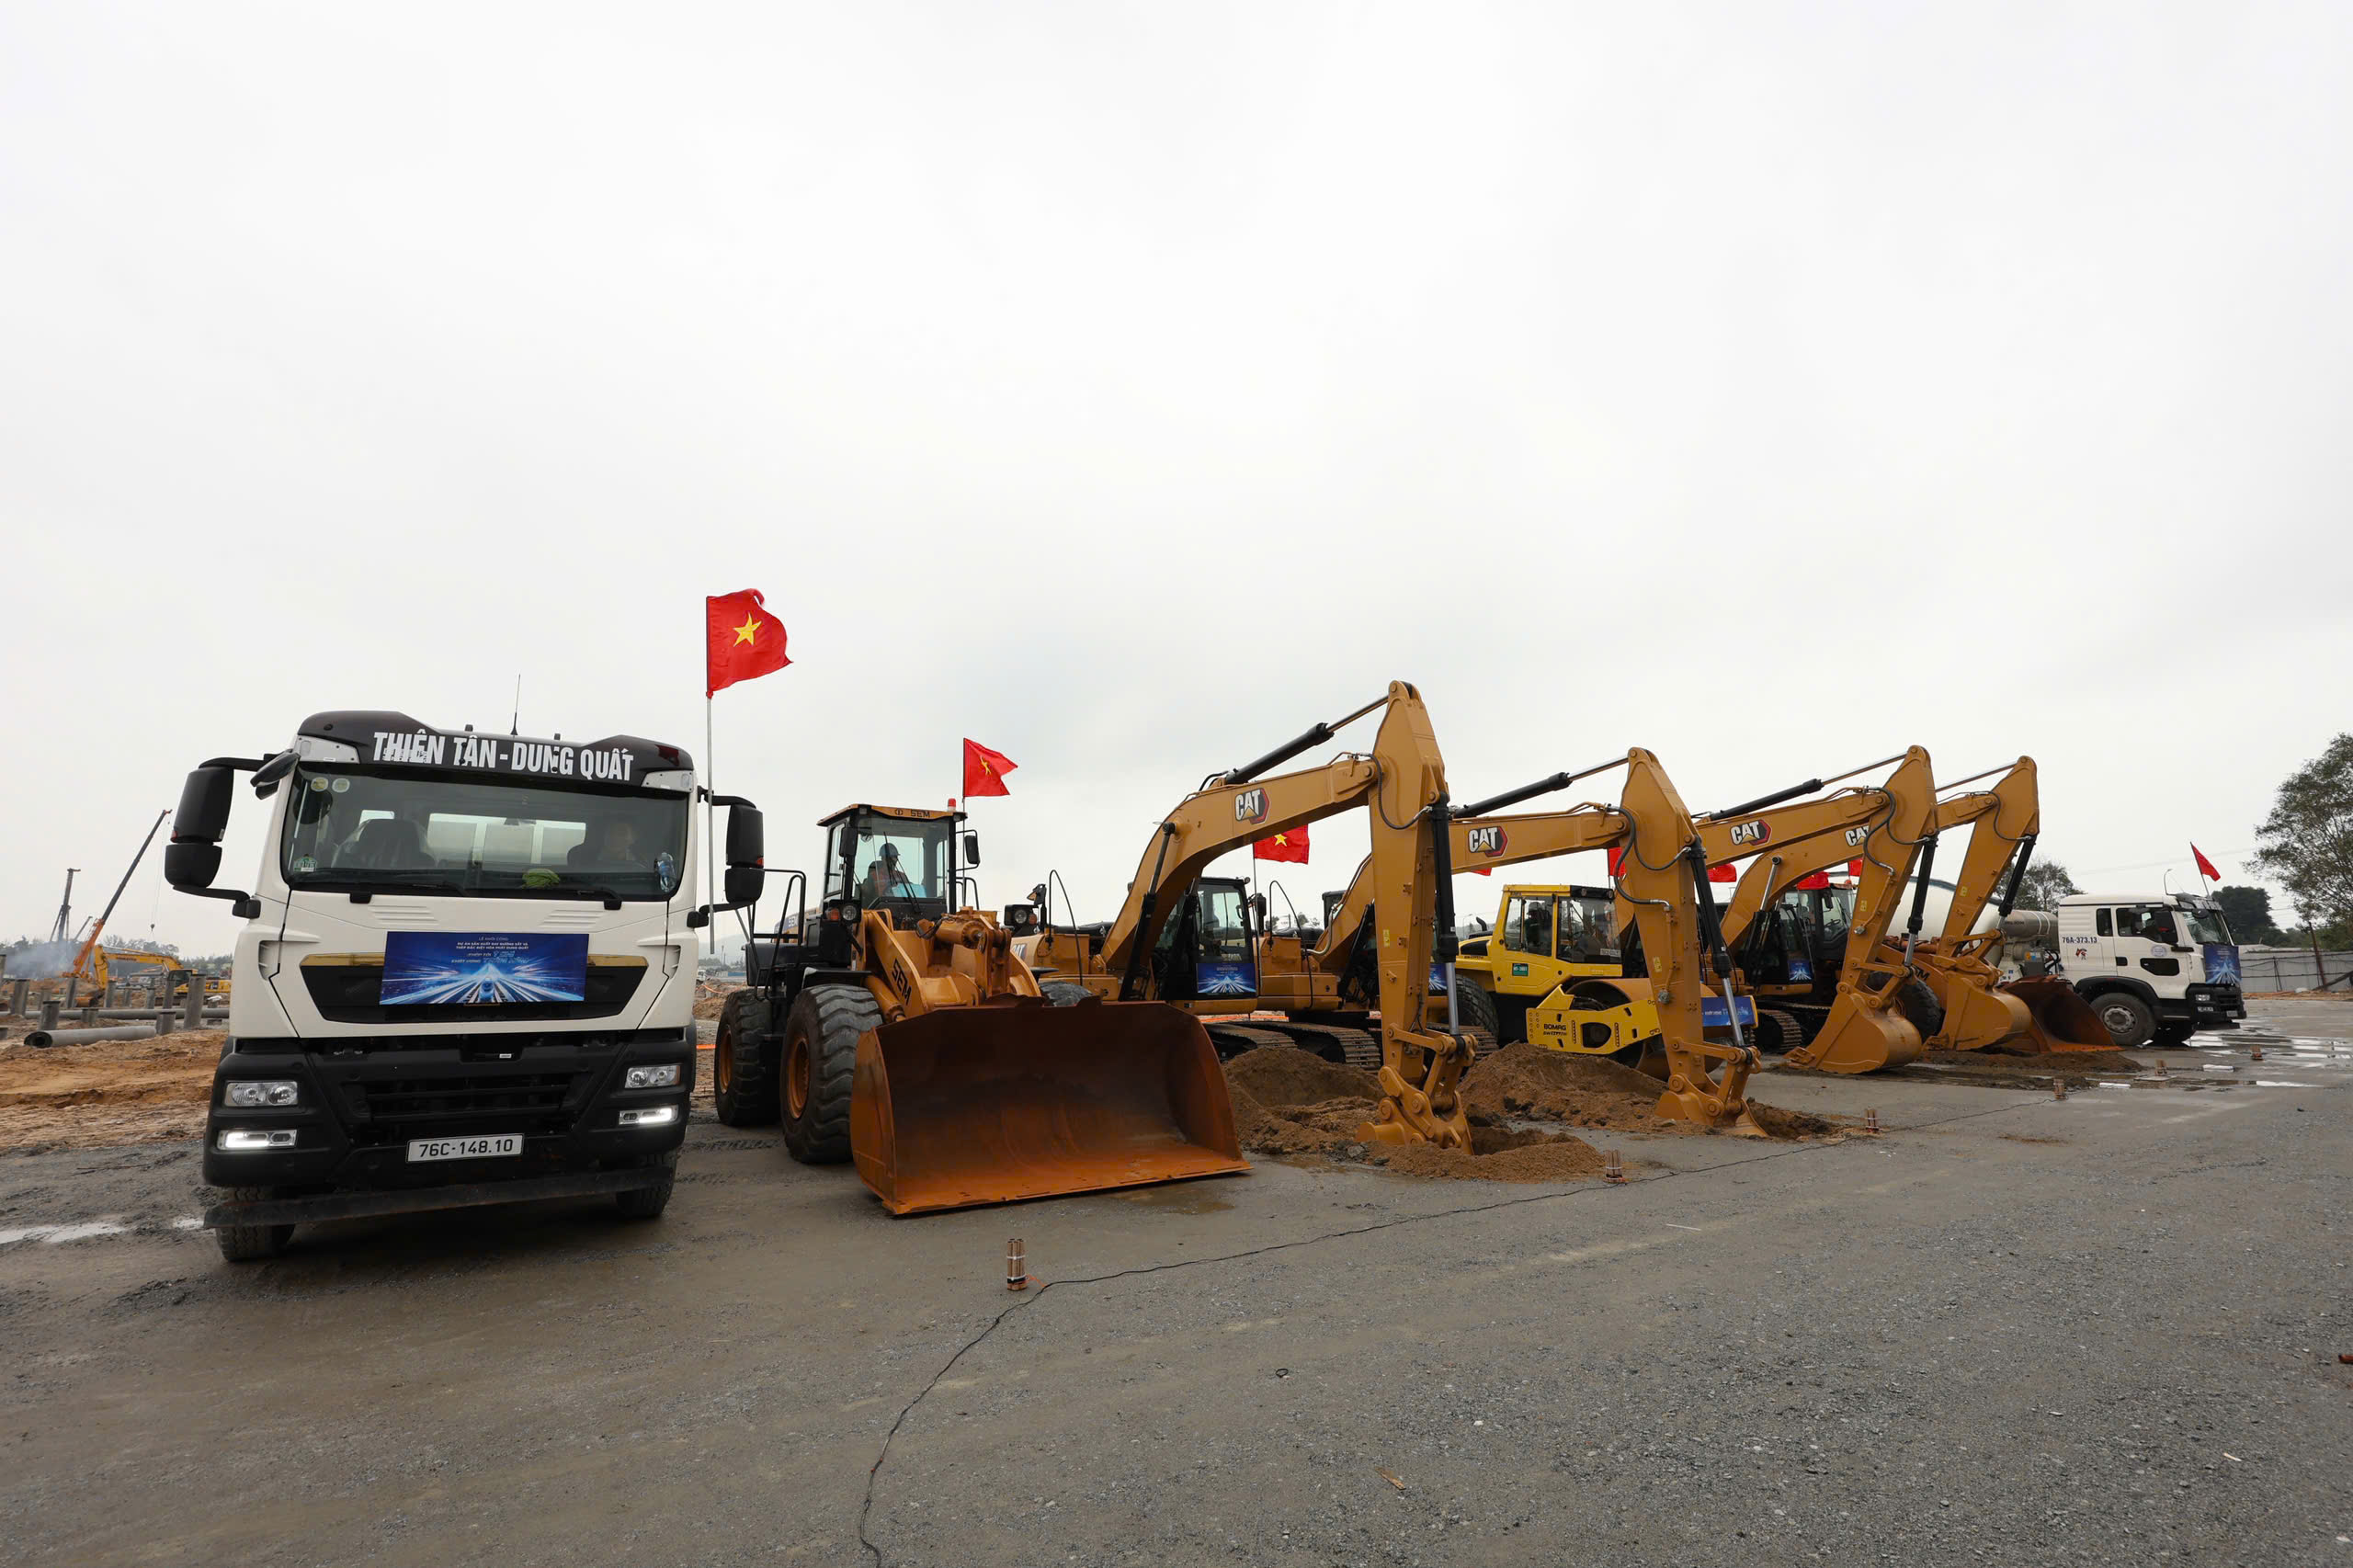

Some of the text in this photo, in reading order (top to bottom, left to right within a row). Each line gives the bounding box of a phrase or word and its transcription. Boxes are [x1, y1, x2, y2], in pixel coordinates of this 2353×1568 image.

[373, 729, 446, 765] THIÊN
[453, 735, 497, 768] TÂN
[580, 747, 634, 781] QUẤT
[1235, 789, 1261, 821] CAT
[1468, 826, 1498, 853] CAT
[1731, 820, 1760, 846] CAT
[892, 958, 912, 1006] SEM
[418, 1139, 514, 1158] 76C-148.10
